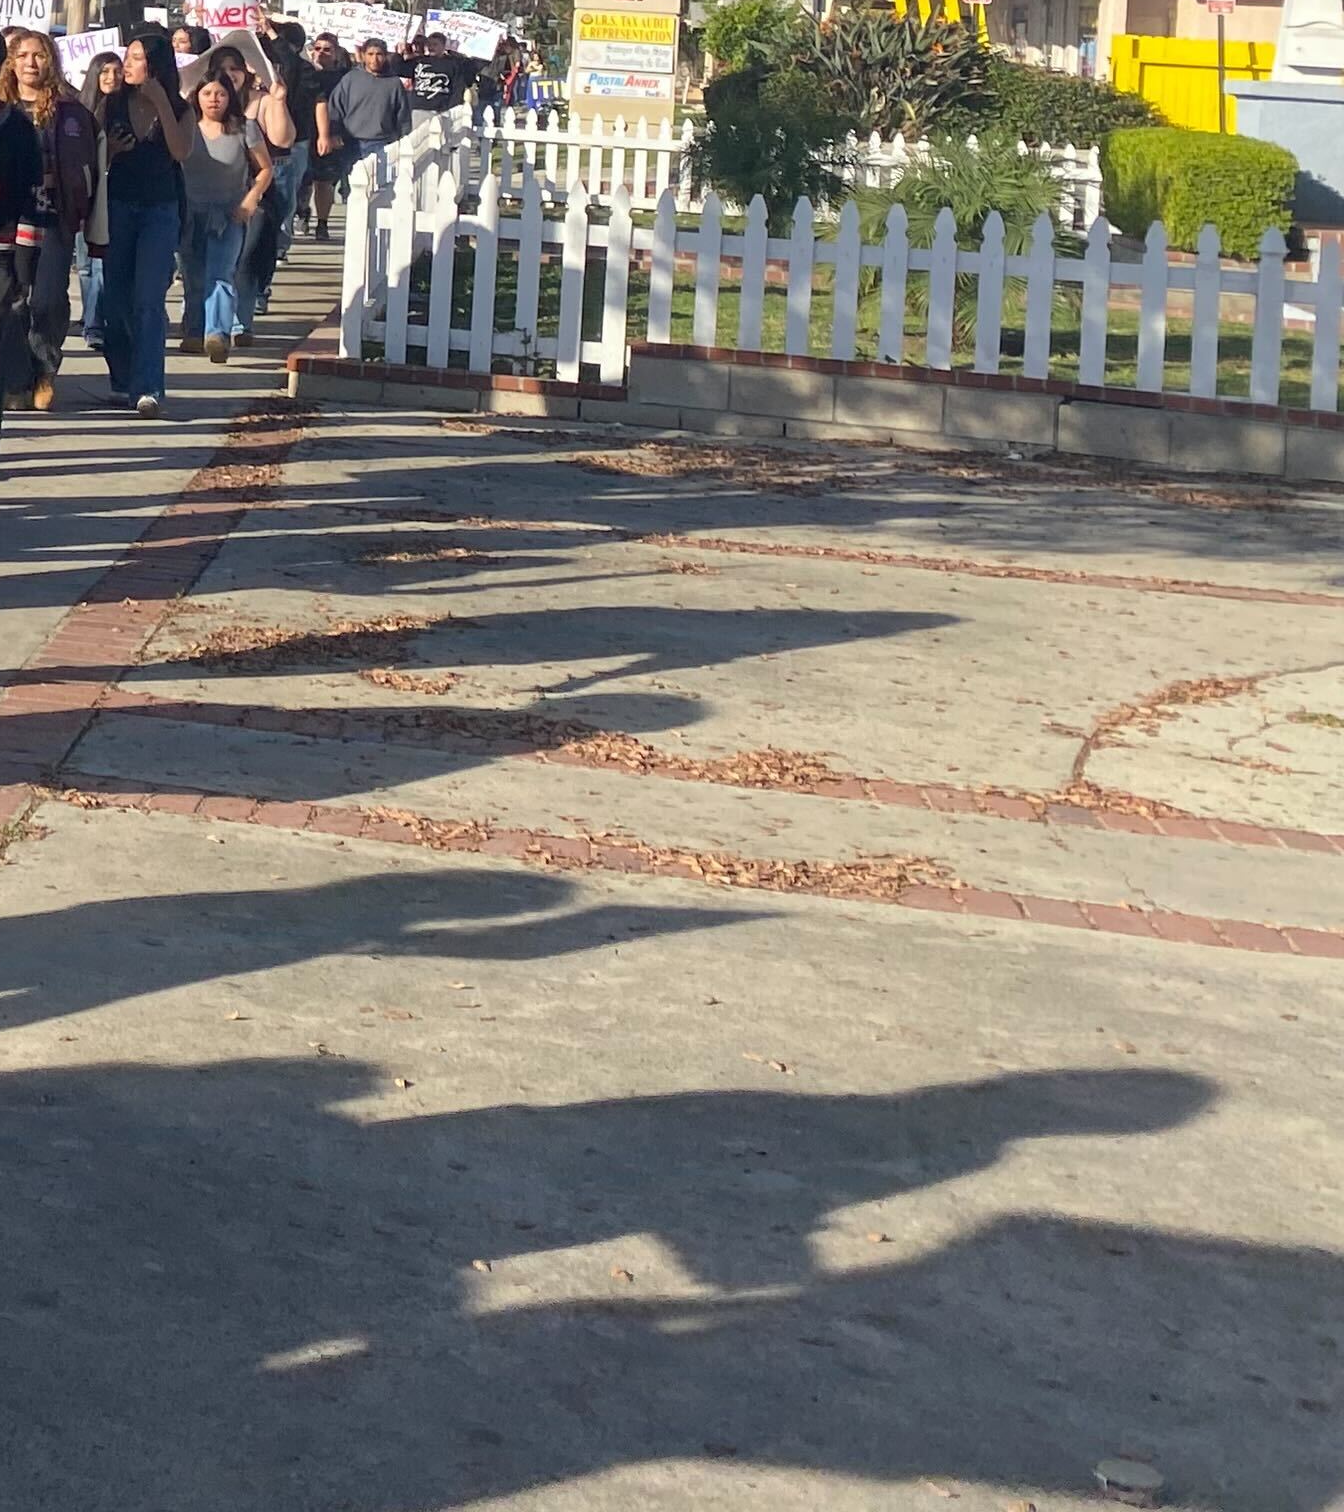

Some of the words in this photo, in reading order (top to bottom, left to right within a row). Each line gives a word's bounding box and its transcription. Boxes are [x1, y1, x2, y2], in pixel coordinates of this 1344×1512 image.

[620, 15, 638, 27] TAX
[641, 17, 669, 29] AUDIT
[590, 26, 672, 41] REPRESENTATION
